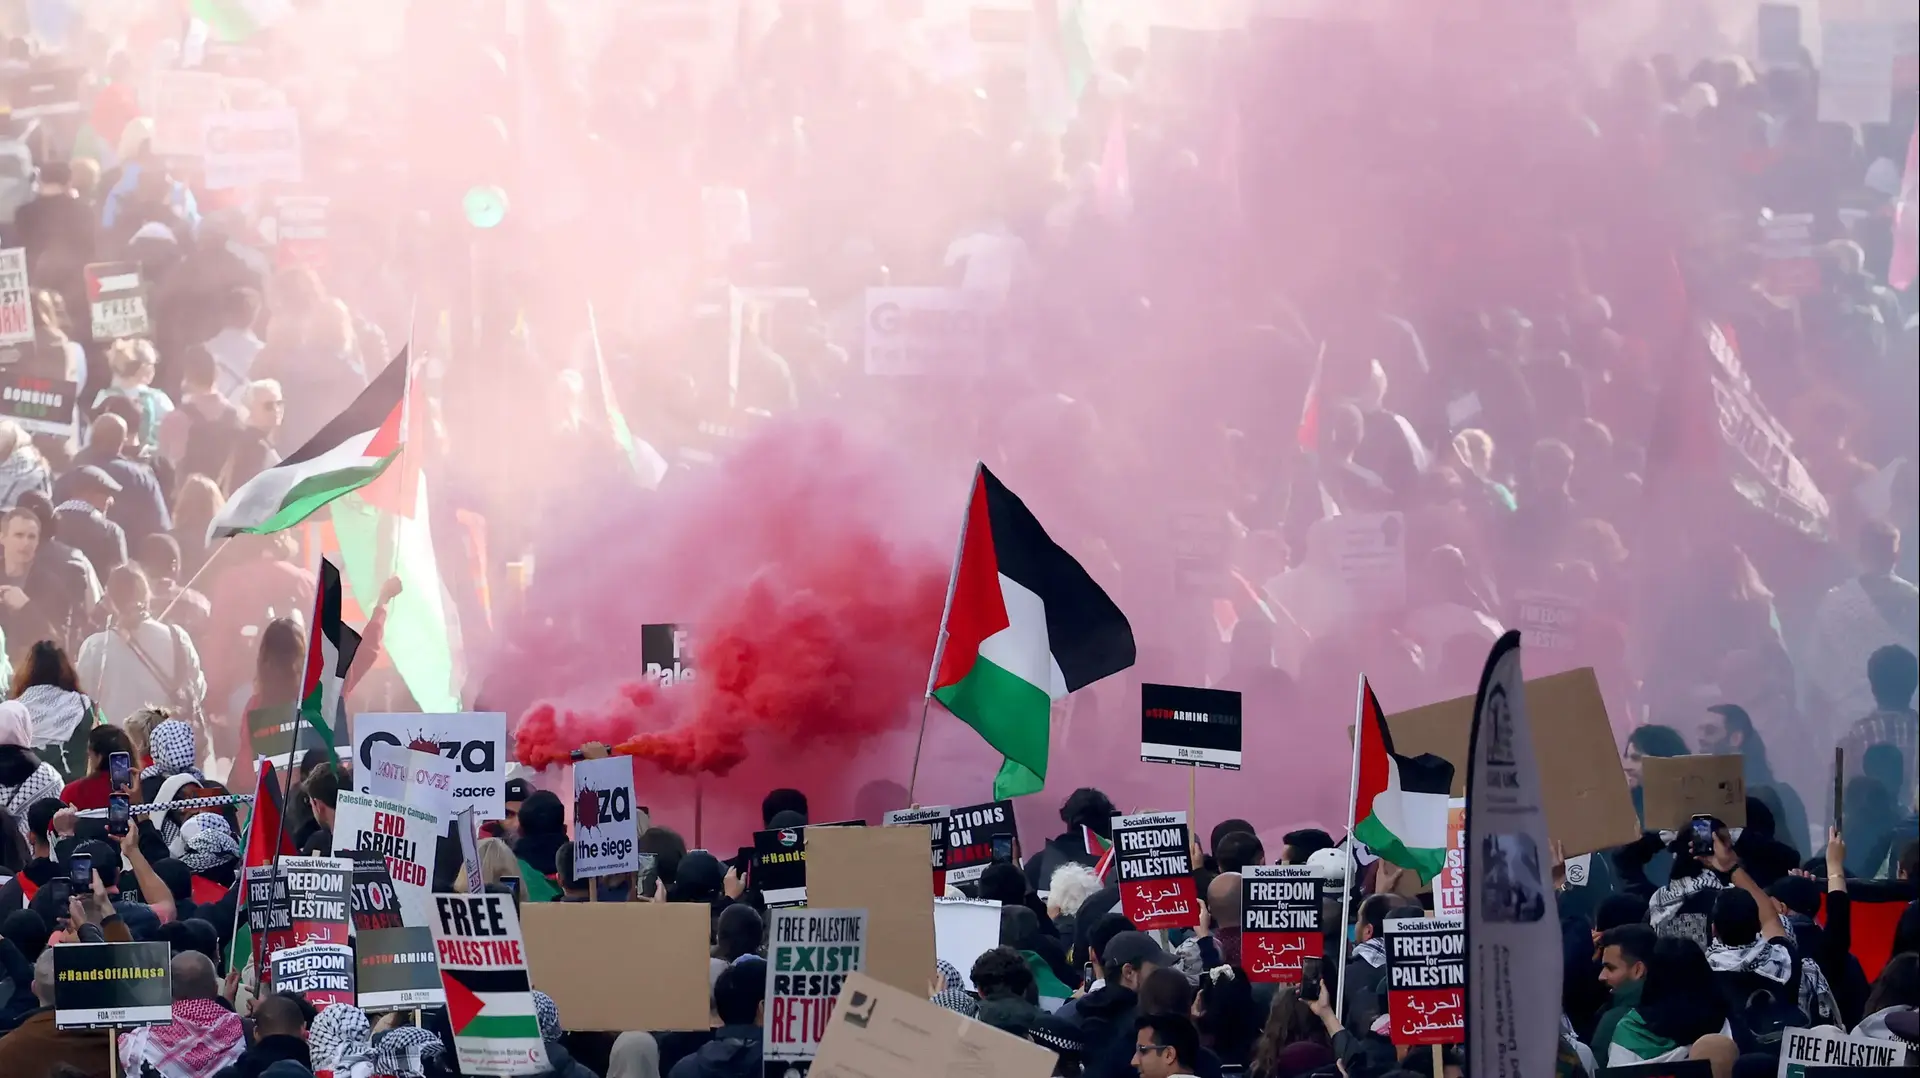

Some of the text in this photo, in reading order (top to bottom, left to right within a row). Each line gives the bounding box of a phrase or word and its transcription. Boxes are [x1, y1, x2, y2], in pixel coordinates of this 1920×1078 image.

[646, 662, 697, 687] Pale
[453, 786, 496, 798] sacre
[338, 793, 438, 825] Palestine Solidarity Campaign
[893, 811, 941, 823] Socialist Worker
[373, 811, 405, 838] END
[949, 807, 1005, 832] CTIONS
[1123, 815, 1176, 827] Socialist Worker
[356, 829, 417, 863] ISRAELI
[578, 837, 633, 860] the siege
[950, 829, 973, 848] ON
[1120, 828, 1182, 851] FREEDOM
[762, 850, 806, 864] #Hands
[1149, 848, 1160, 857] for
[285, 859, 341, 869] Socialist Worker
[385, 856, 427, 887] THEID
[1120, 855, 1189, 879] PALESTINE
[1254, 868, 1311, 877] Socialist Worker
[288, 873, 344, 892] REEDOM
[1136, 882, 1181, 903] الحرية
[1250, 882, 1314, 900] FREEDOM
[305, 891, 316, 900] for
[351, 881, 393, 911] STOP
[1277, 900, 1289, 909] for
[1442, 887, 1464, 907] TE
[252, 908, 291, 930] PALSTINE
[291, 900, 345, 920] LESTINE
[435, 897, 508, 937] FREE
[1133, 900, 1189, 922] لفلسطين
[1246, 910, 1318, 928] PALESTINE
[777, 917, 861, 942] FREE PALESTINE
[1397, 920, 1462, 931] Socialist Worker
[283, 947, 314, 957] Socialist
[436, 939, 523, 966] PALESTINE
[1258, 936, 1305, 955] الحرية
[1393, 934, 1464, 957] FREEDOM
[279, 955, 345, 975] FREEDOM
[775, 946, 860, 972] EXIST!
[1425, 955, 1438, 966] for
[58, 967, 165, 982] #HandsOffAlAqsa
[1391, 964, 1464, 987] PALESTIN
[276, 976, 349, 994] PALESTINE
[1407, 993, 1461, 1015] الحرية
[1401, 1013, 1465, 1035] فلسطين
[1788, 1034, 1897, 1067] FREE PALESTINE
